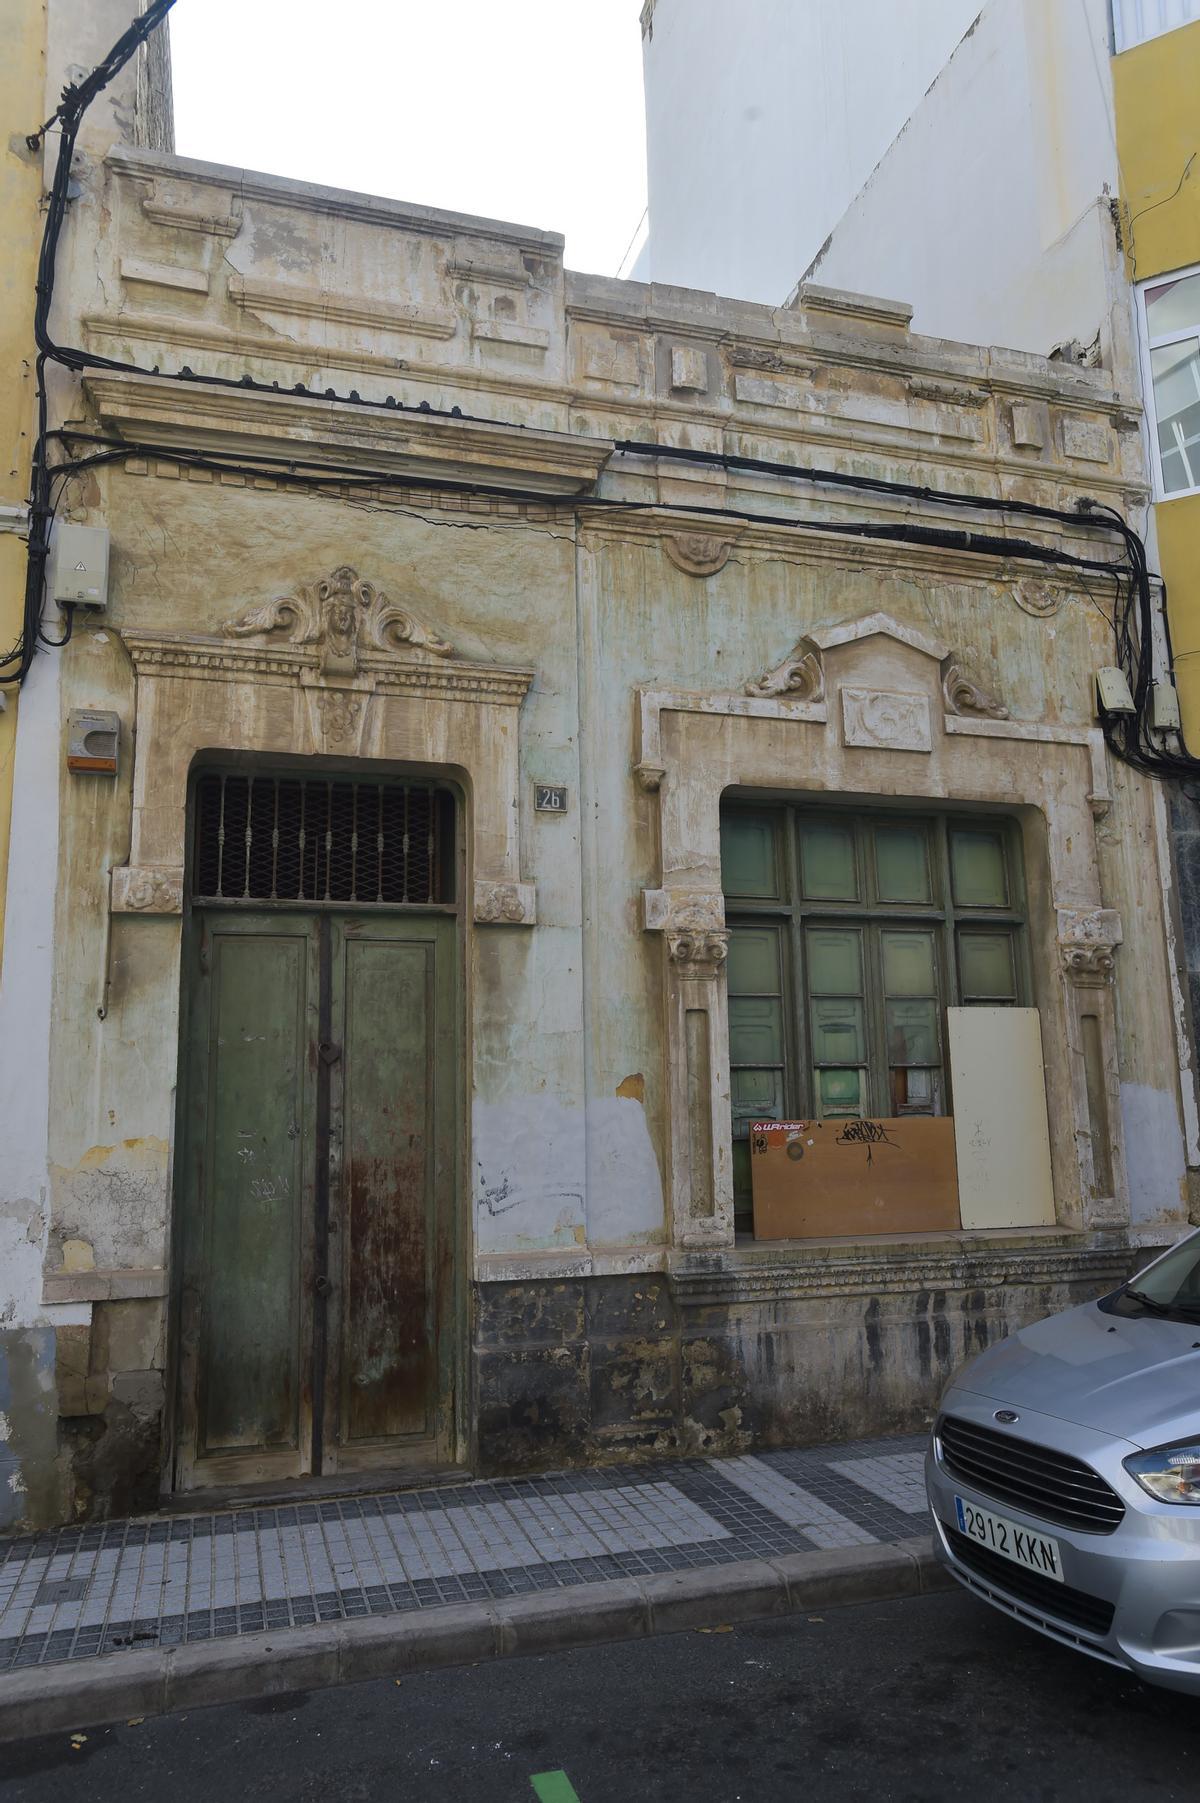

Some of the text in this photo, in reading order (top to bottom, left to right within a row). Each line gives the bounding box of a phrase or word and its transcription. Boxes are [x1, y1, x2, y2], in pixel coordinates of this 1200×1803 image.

[543, 788, 560, 808] 26
[965, 1507, 1057, 1574] 2912 KKN
